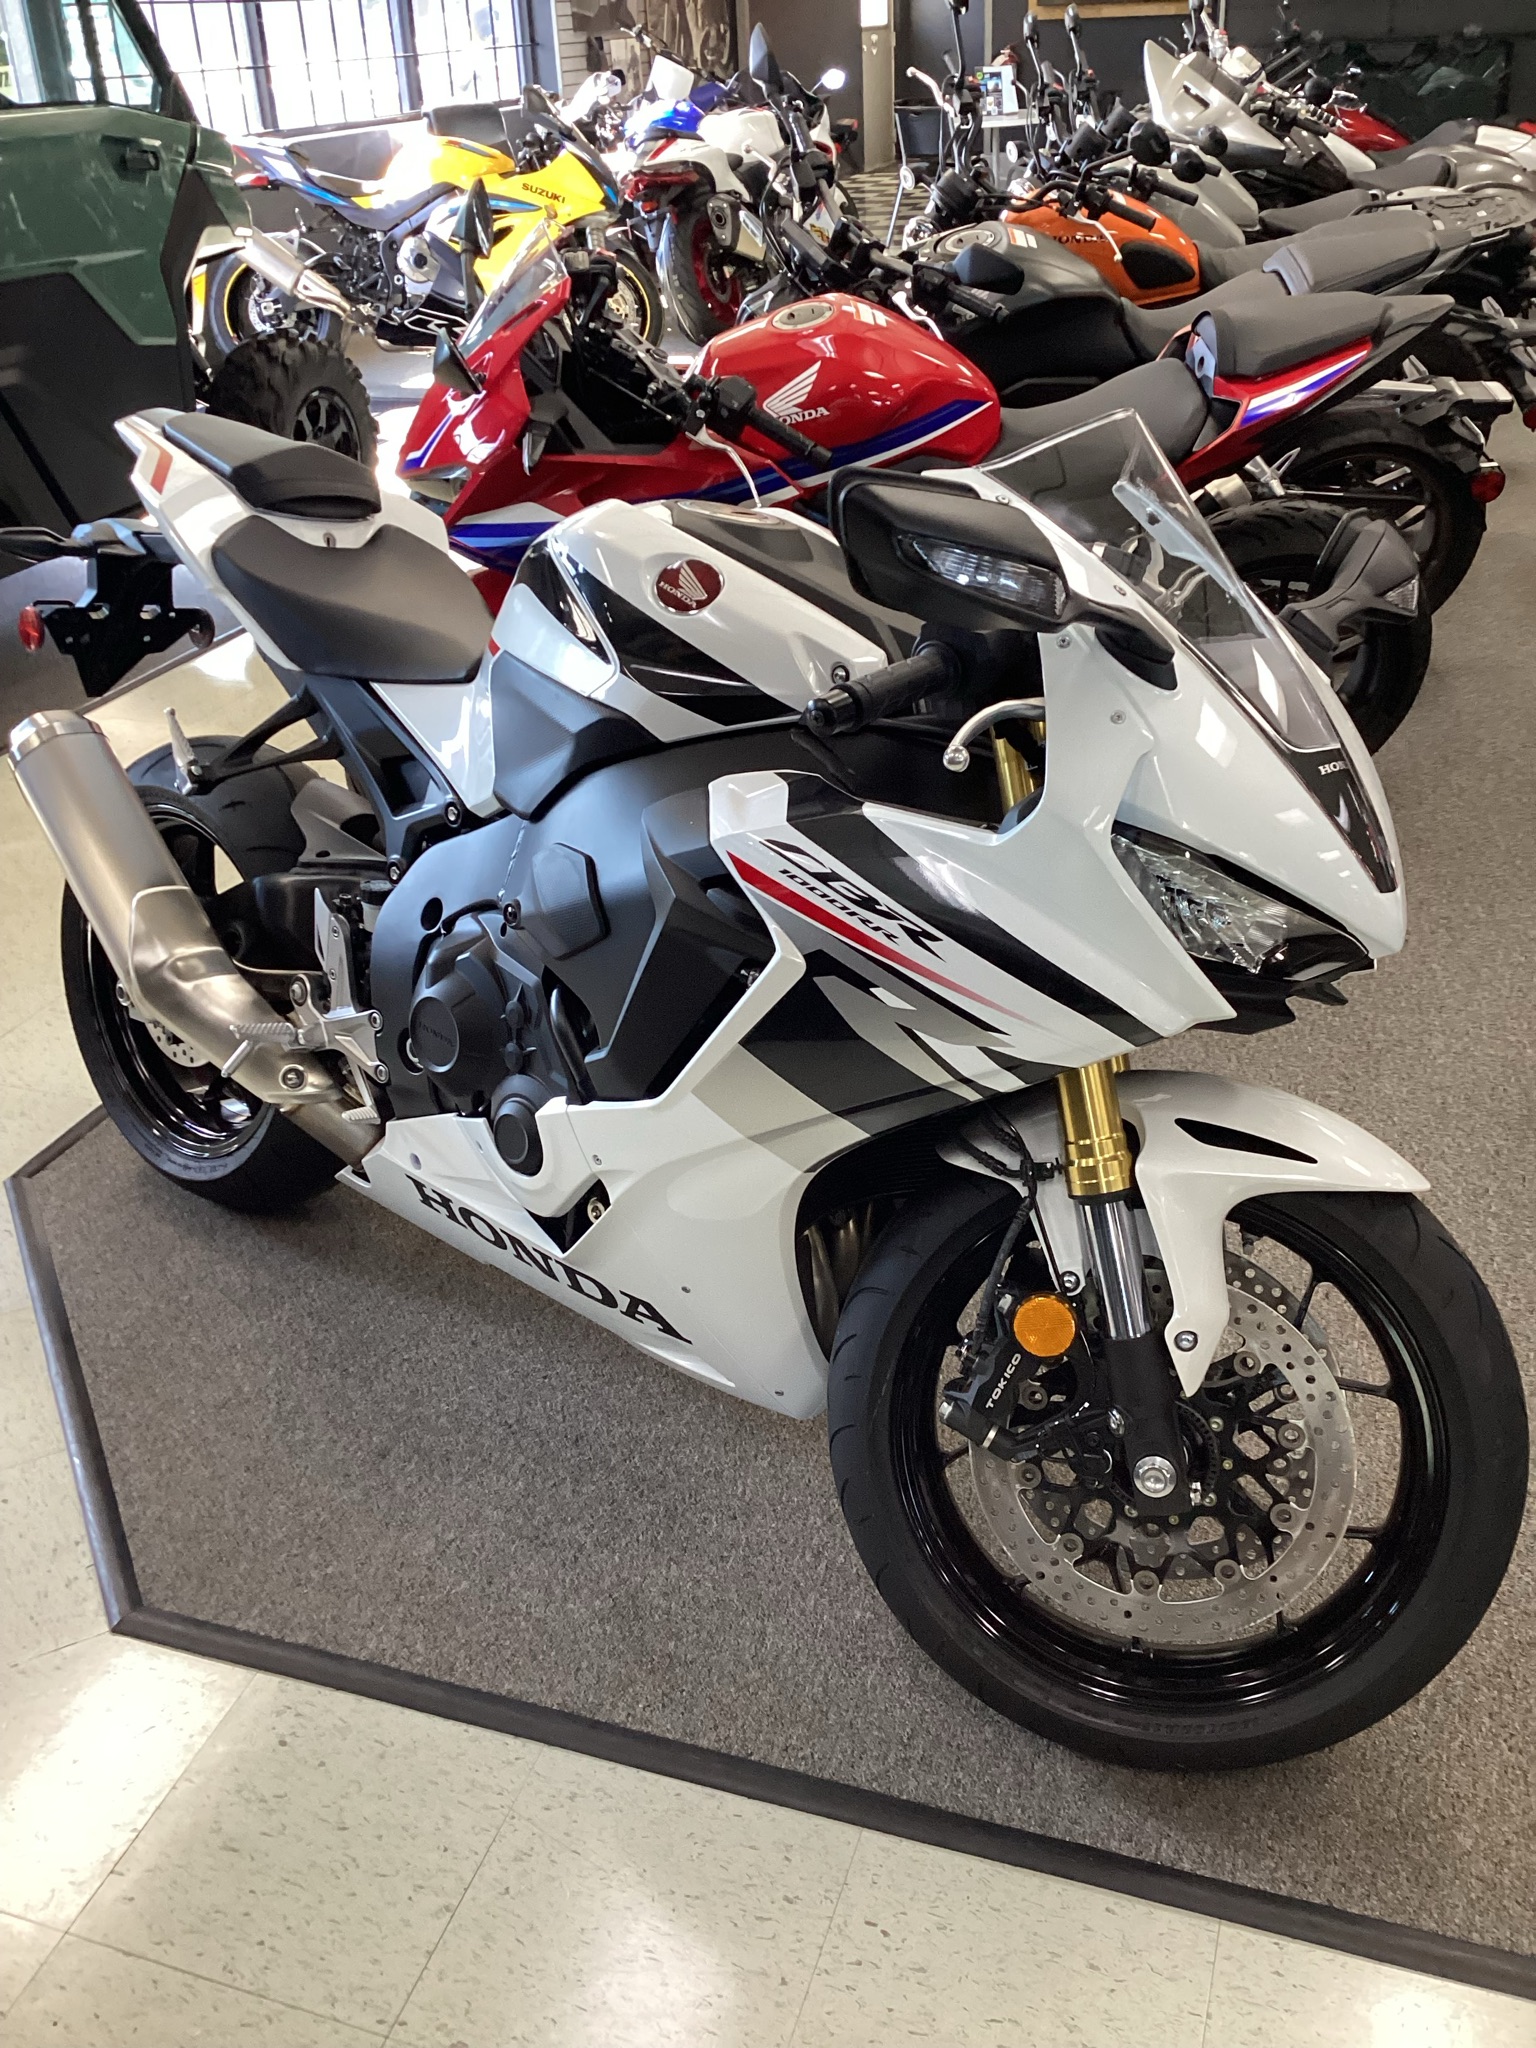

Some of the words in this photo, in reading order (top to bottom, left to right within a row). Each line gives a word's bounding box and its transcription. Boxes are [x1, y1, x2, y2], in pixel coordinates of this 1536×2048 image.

[521, 182, 566, 204] SUZUKI
[1053, 234, 1108, 244] OND
[778, 406, 831, 426] ONDA
[658, 580, 697, 609] HONDA
[759, 838, 947, 963] CBR
[778, 868, 900, 946] 1000RR
[405, 1173, 693, 1345] HONDA
[985, 1353, 1022, 1409] TOKICO
